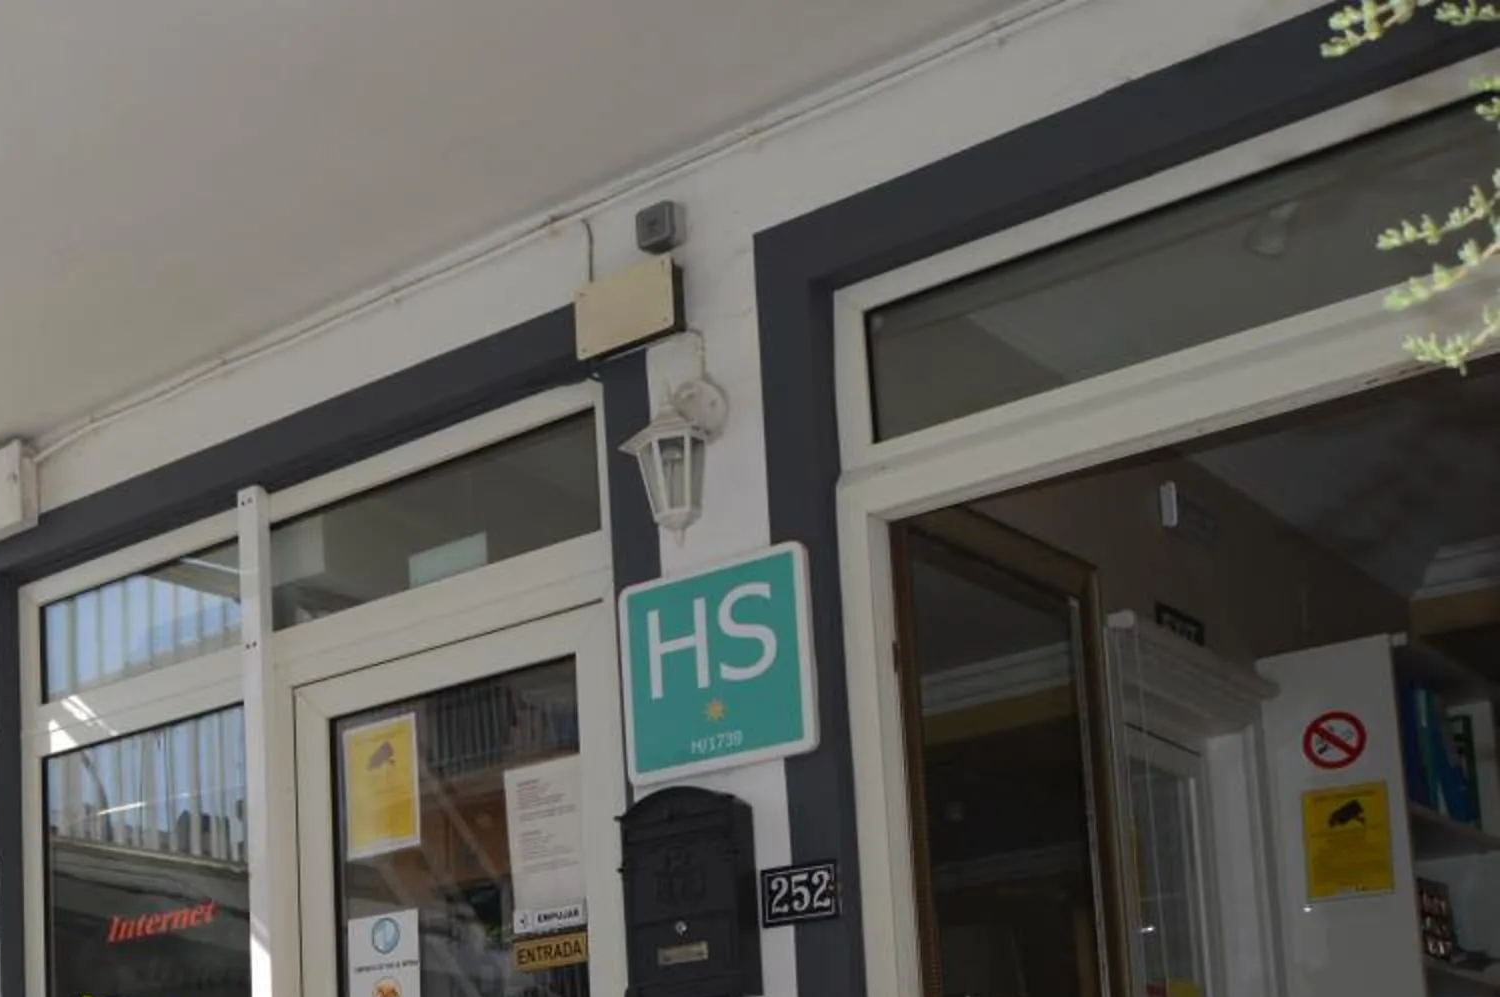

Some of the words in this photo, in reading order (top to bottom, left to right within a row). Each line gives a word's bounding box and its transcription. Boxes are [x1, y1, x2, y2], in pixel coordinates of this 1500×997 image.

[646, 581, 778, 701] HS
[770, 869, 831, 915] 252
[107, 899, 214, 944] Internet
[516, 939, 583, 966] ENTRADA
